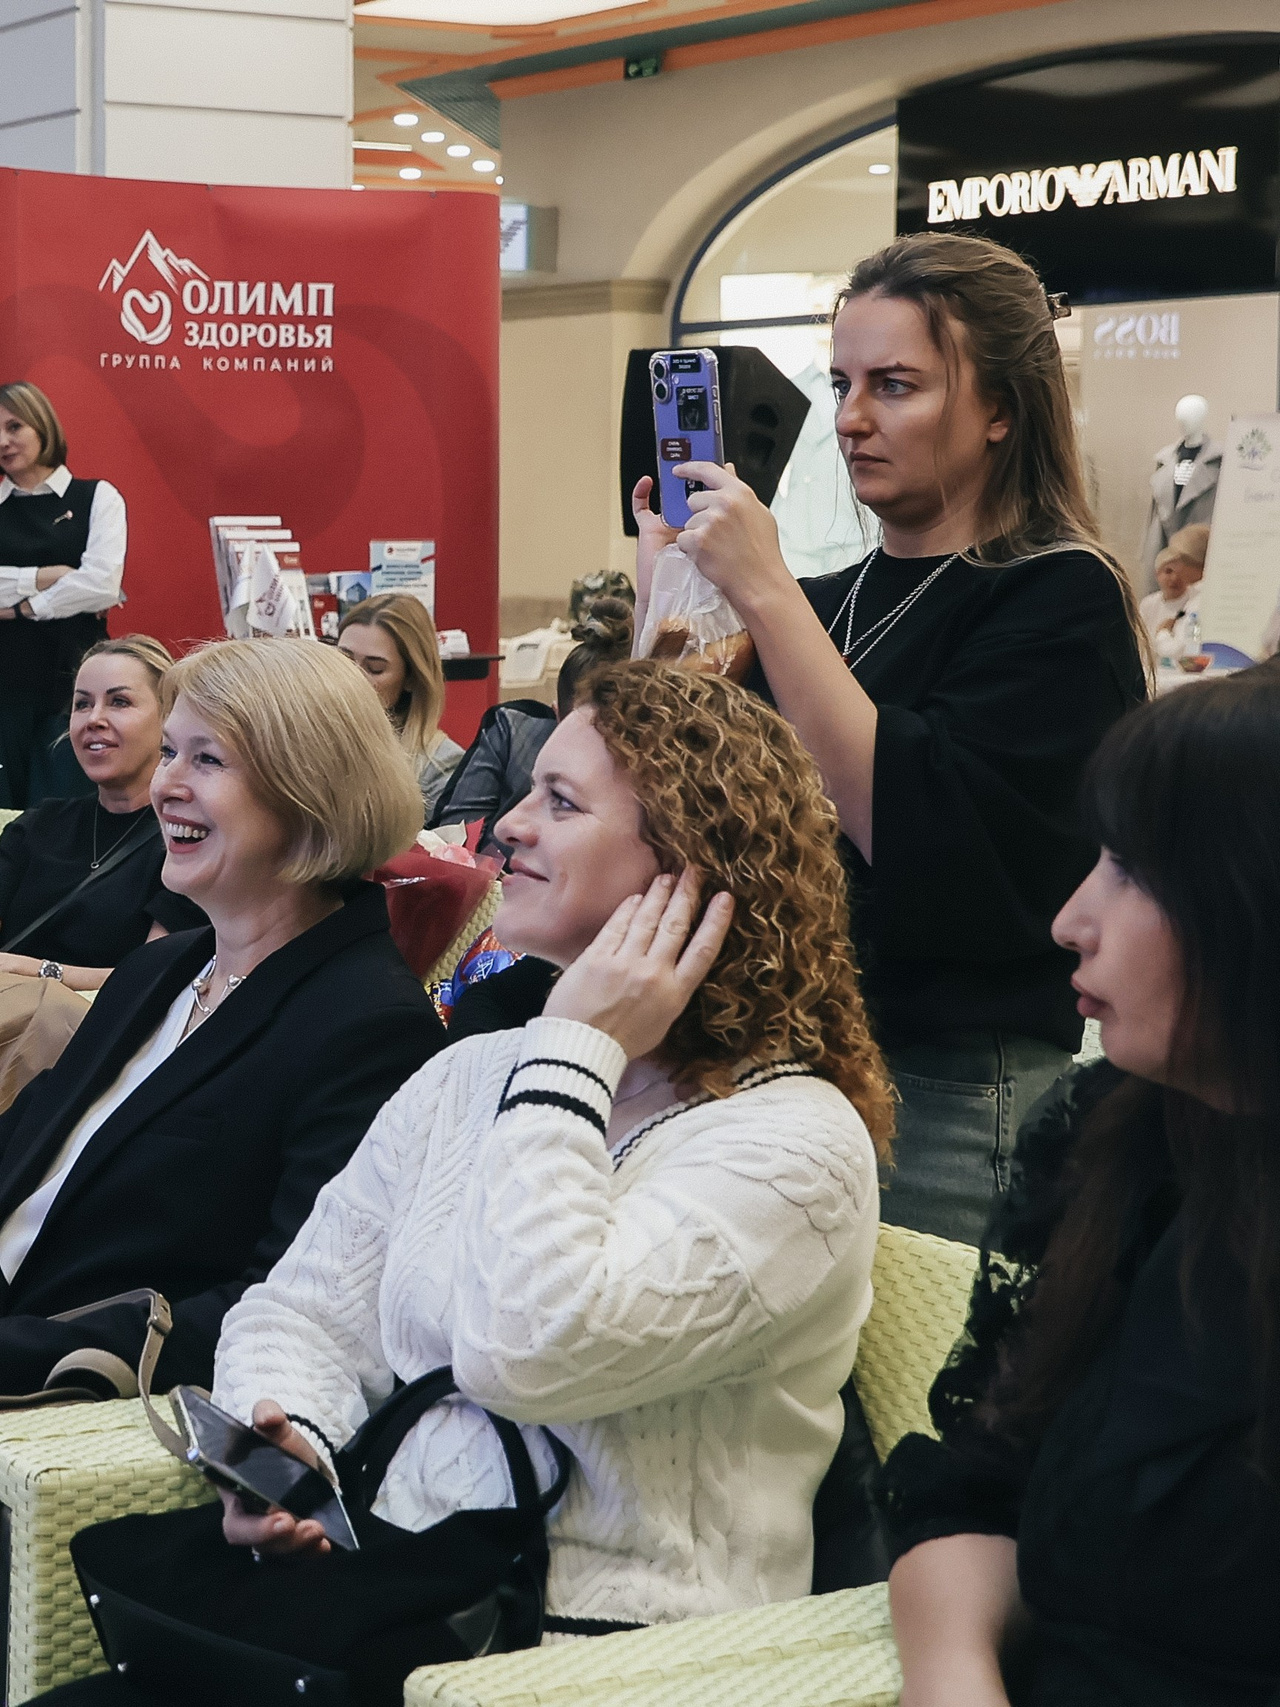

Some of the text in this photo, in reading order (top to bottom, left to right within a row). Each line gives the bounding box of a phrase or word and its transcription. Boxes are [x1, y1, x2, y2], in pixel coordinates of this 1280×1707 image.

[927, 146, 1239, 223] EMPORIO ARMANI
[182, 279, 335, 317] ОЛИМП
[183, 321, 333, 350] ЗДОРОВЬЯ
[99, 352, 334, 373] ГРУППА КОМПАНИЙ
